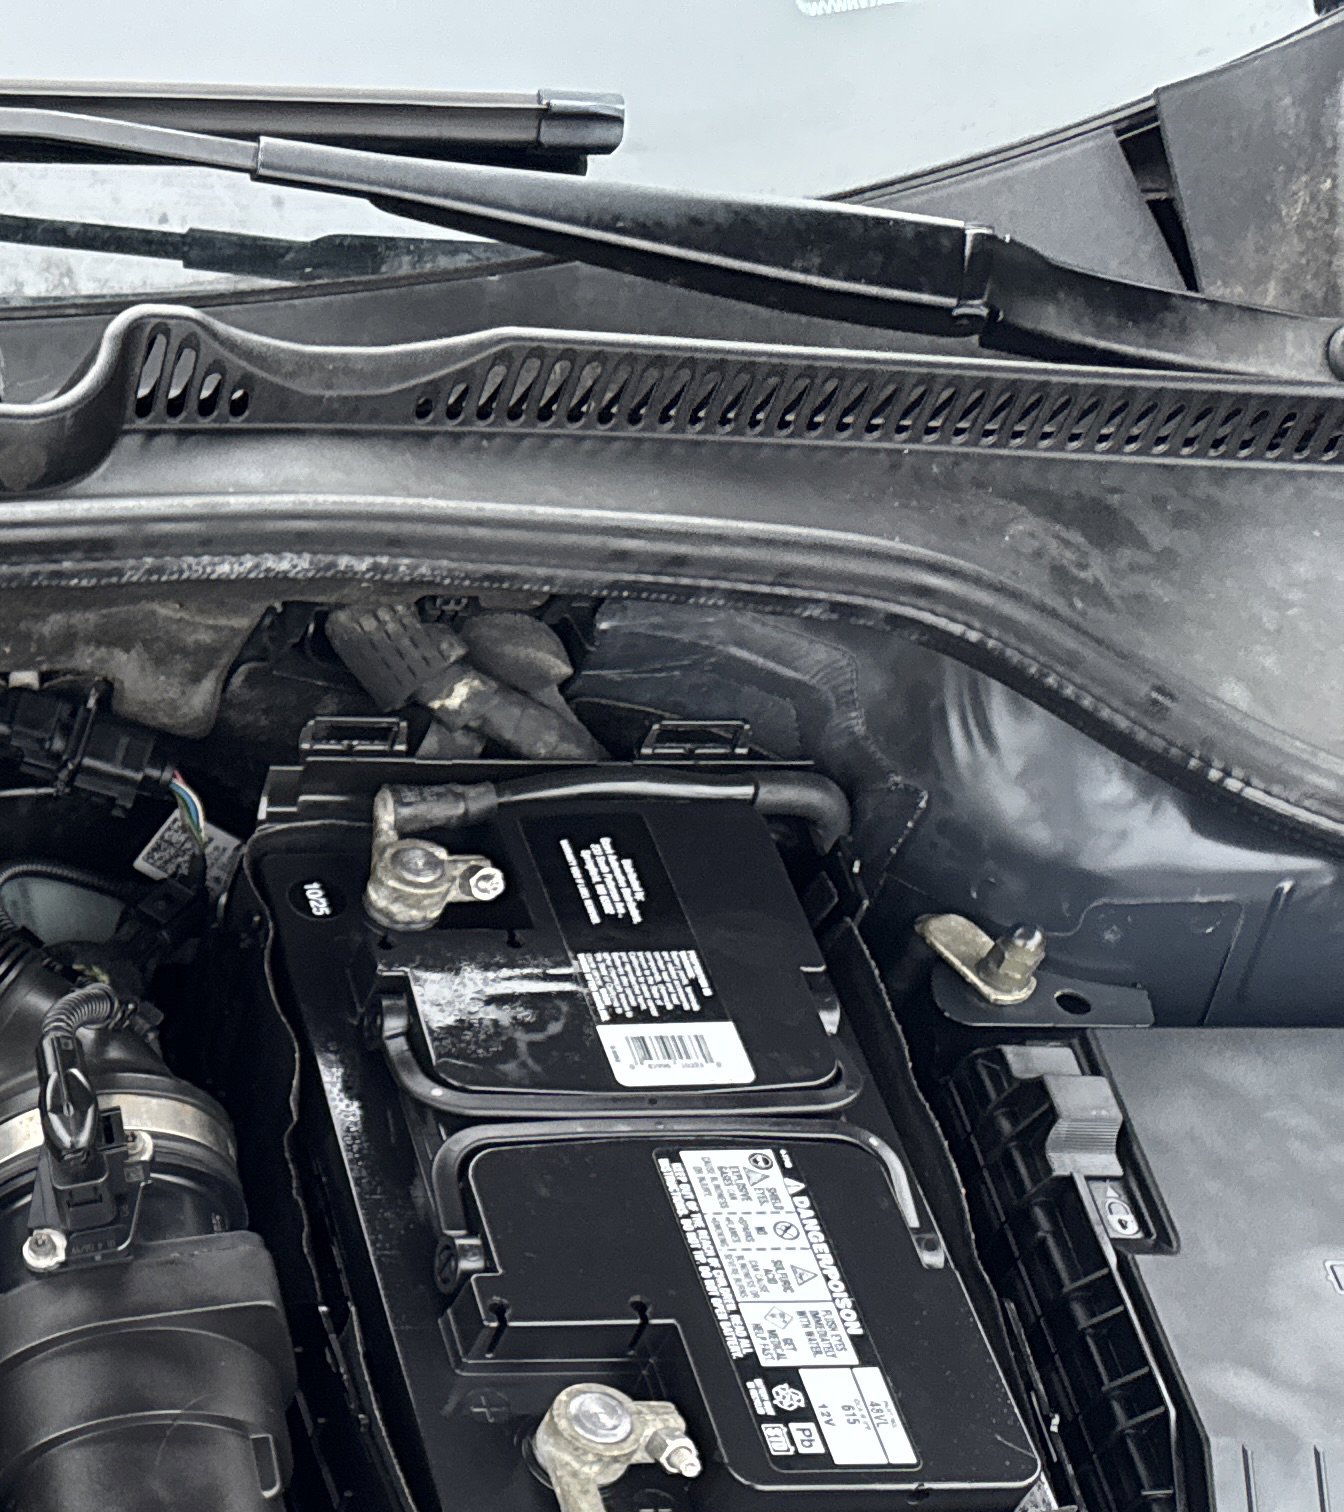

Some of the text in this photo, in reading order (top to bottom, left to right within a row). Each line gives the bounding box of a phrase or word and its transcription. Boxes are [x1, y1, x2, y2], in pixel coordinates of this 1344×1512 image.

[303, 882, 332, 916] 10/25
[793, 1196, 863, 1335] DANGER/POISON
[818, 1403, 835, 1427] 12V
[840, 1404, 860, 1426] 615
[796, 1428, 816, 1449] Pb
